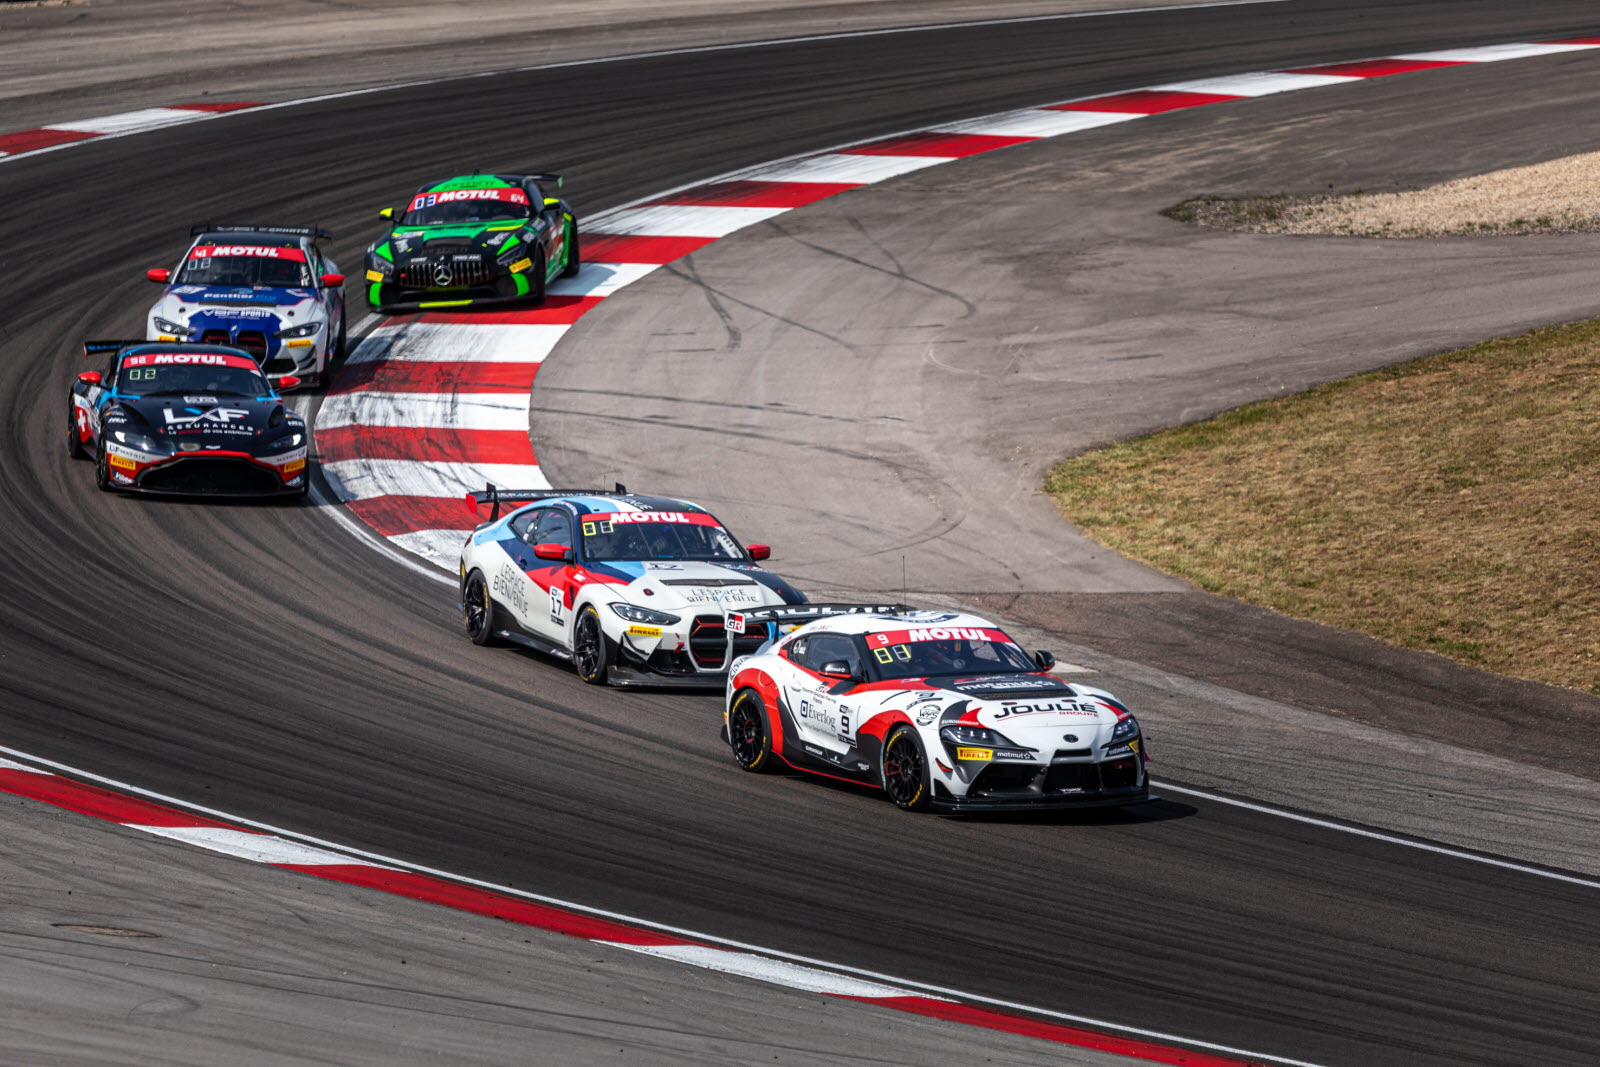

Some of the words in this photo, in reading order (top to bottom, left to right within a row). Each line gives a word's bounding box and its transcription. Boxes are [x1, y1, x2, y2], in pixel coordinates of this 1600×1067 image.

[438, 190, 500, 202] MOTUL
[212, 246, 279, 257] MOTUL
[154, 354, 227, 365] MOTUL
[167, 423, 254, 431] ASSURANCES
[610, 512, 689, 523] MOTUL
[551, 597, 562, 616] 17
[726, 619, 742, 631] GR
[629, 626, 659, 636] PIRELLI
[908, 628, 992, 642] MOTUL
[877, 634, 890, 645] 9
[994, 701, 1098, 719] JOULIÉ
[809, 703, 836, 732] Everlog
[841, 715, 850, 735] 9
[959, 749, 990, 759] PIRELLI
